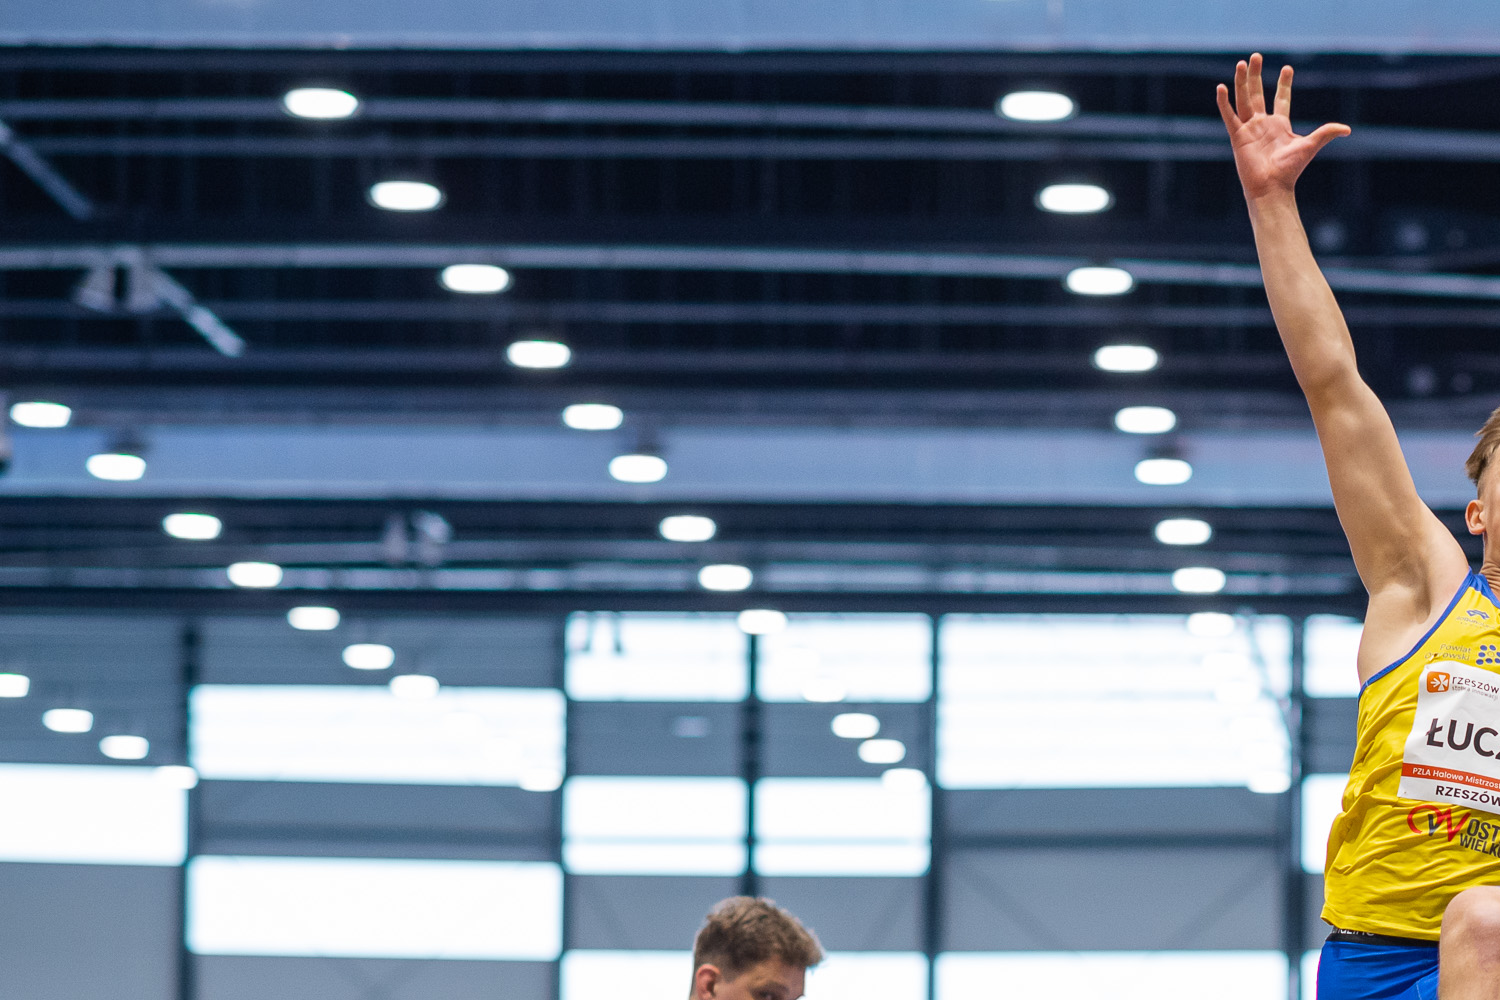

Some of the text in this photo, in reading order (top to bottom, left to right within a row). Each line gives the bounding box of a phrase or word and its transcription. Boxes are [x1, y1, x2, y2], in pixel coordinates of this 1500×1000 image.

[1440, 643, 1472, 654] Powiat
[1412, 767, 1431, 776] PZLA
[1432, 770, 1464, 781] Halowe
